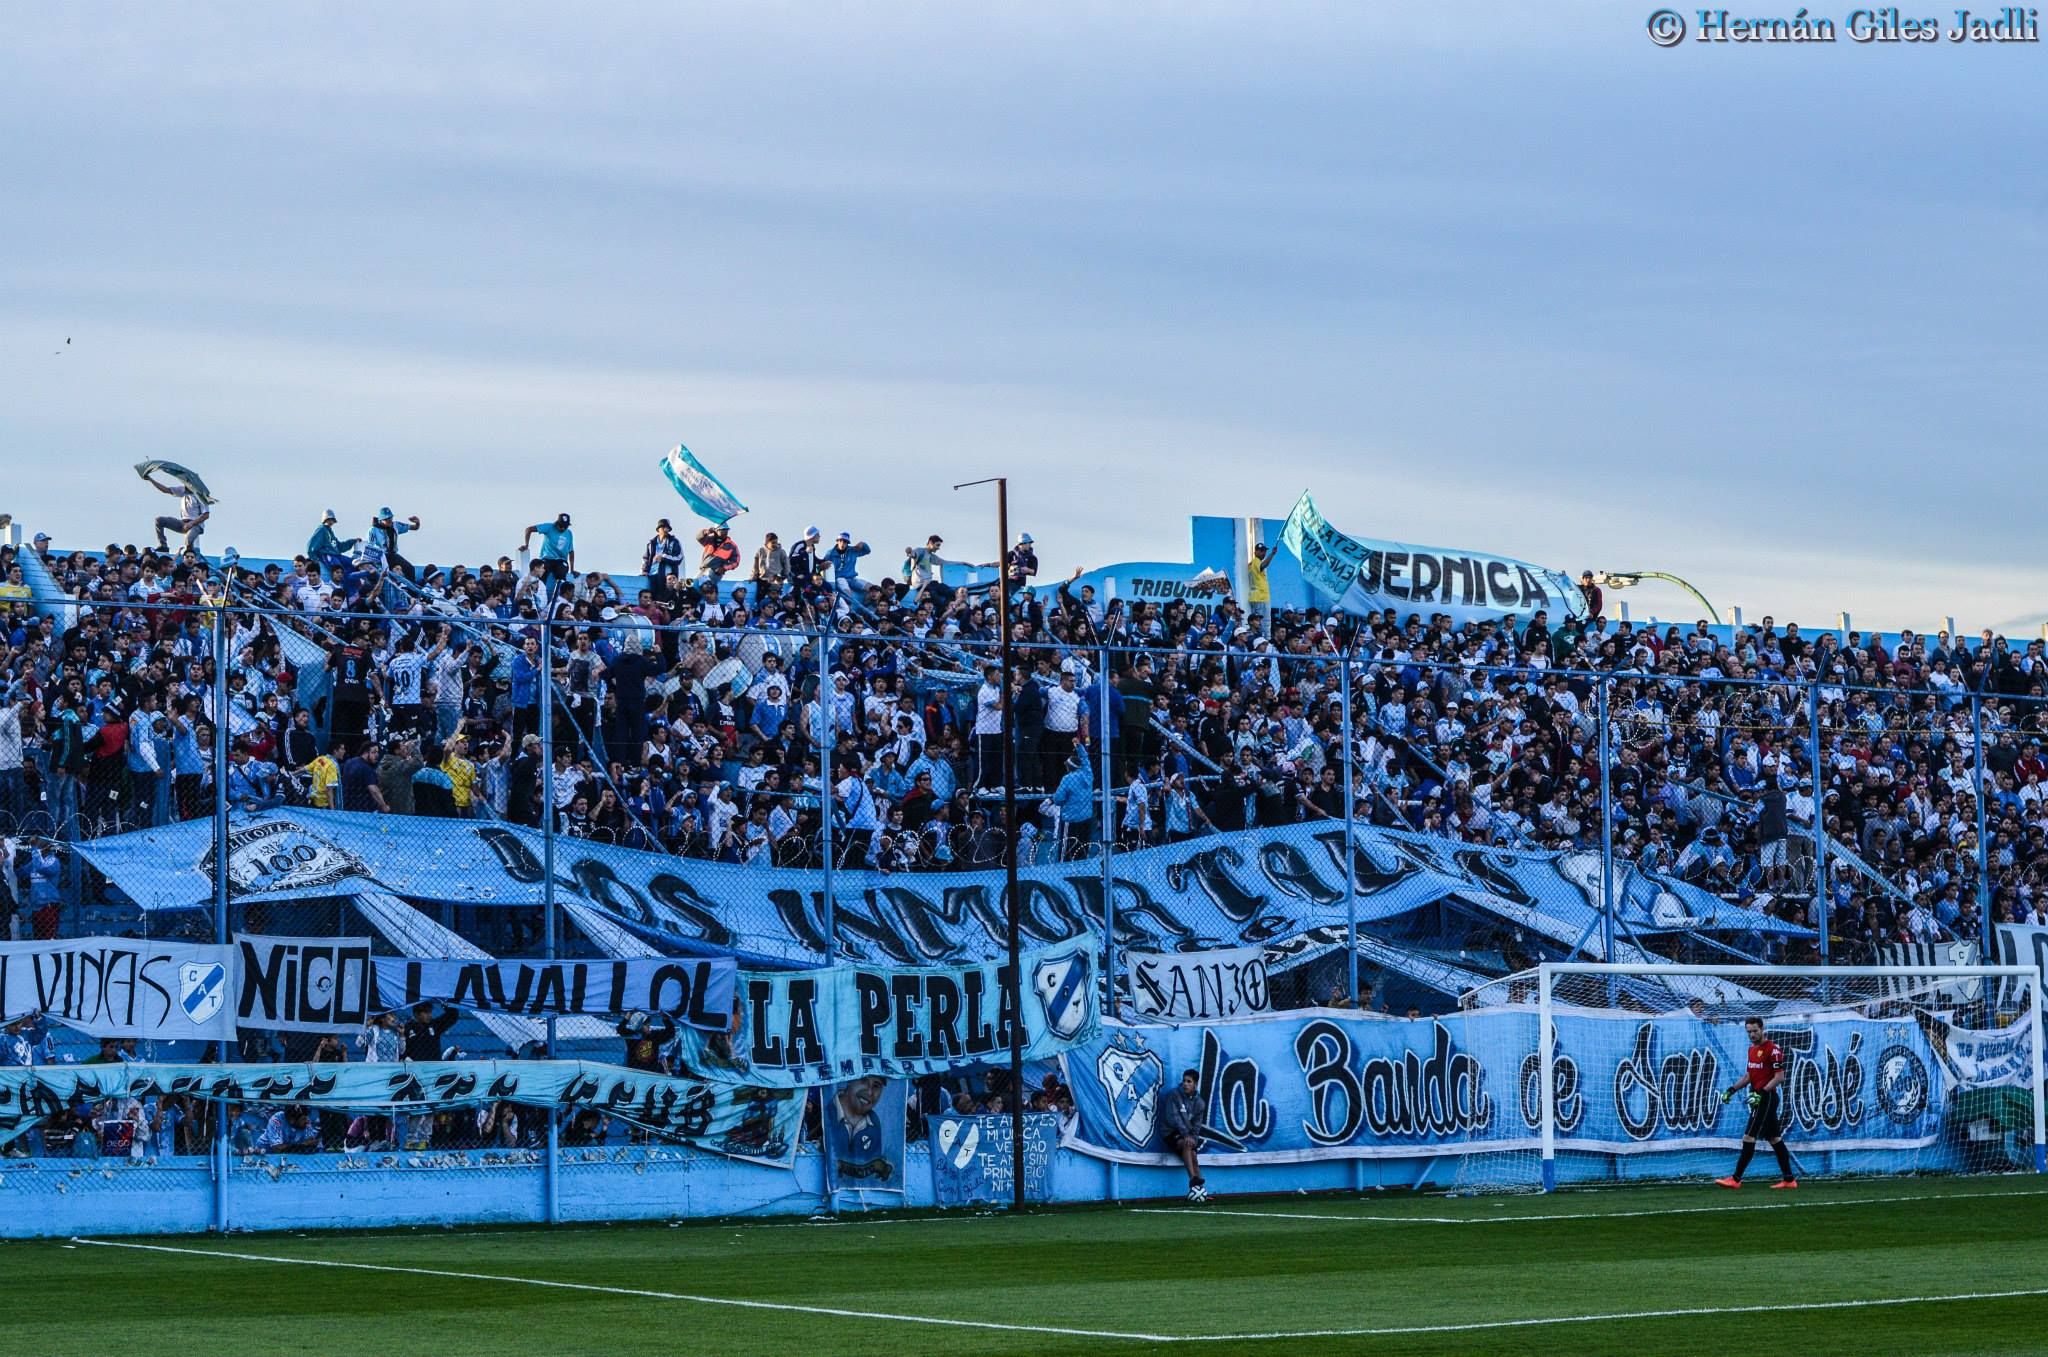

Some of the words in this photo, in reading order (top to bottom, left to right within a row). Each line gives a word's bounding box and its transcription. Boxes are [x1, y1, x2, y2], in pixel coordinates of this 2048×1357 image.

[249, 844, 318, 877] 100
[748, 979, 825, 1067] LA
[855, 964, 1030, 1060] PERLA
[1196, 1027, 1270, 1153] La
[1294, 1018, 1490, 1147] Banda
[1519, 1021, 1583, 1132] de
[1614, 1020, 1721, 1142] San
[976, 1114, 995, 1129] TE
[1039, 1113, 1057, 1127] ES
[986, 1128, 999, 1142] MI
[1002, 1126, 1041, 1141] UCA
[995, 1140, 1047, 1153] VEDAD
[977, 1152, 996, 1168] TE
[1028, 1154, 1048, 1167] SIN
[983, 1167, 1045, 1180] PRINPIO
